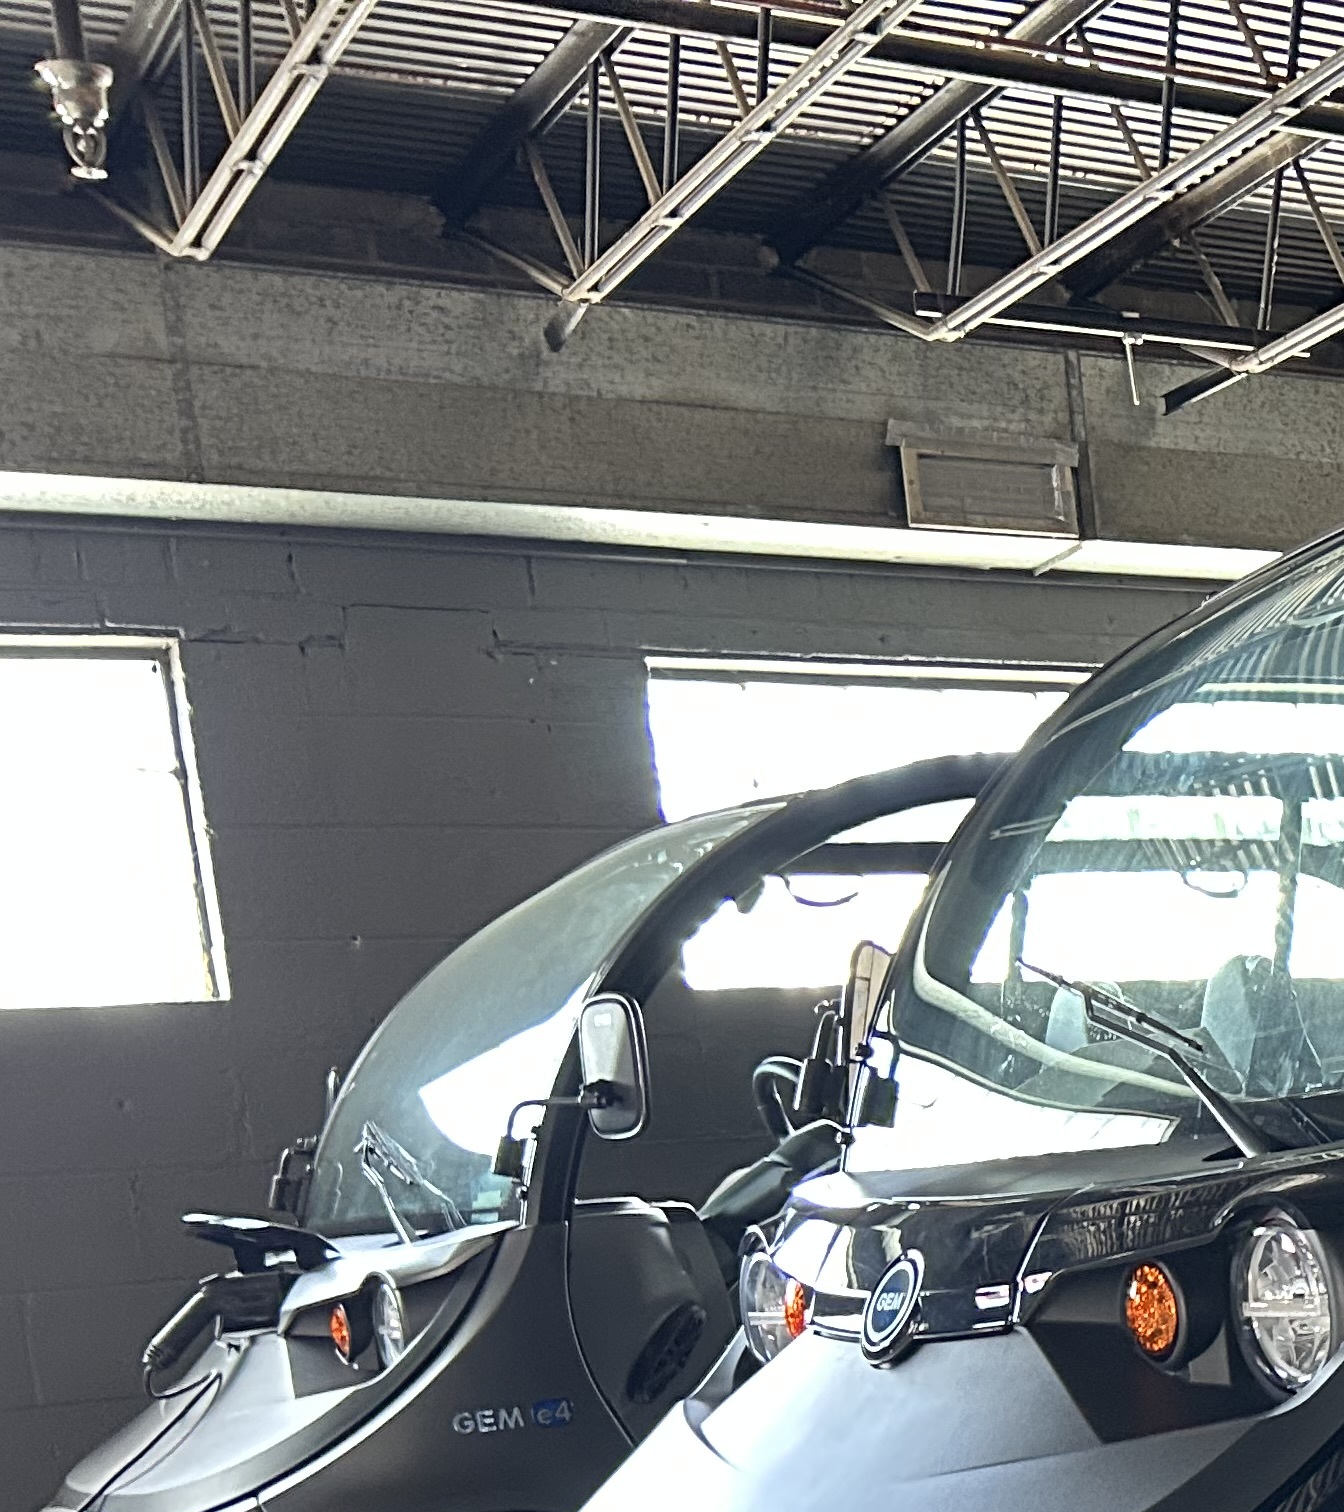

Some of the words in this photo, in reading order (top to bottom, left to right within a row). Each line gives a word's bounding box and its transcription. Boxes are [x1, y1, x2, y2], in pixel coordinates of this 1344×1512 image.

[876, 1291, 904, 1312] GEM
[452, 1406, 525, 1434] GEM
[536, 1400, 572, 1425] e4
